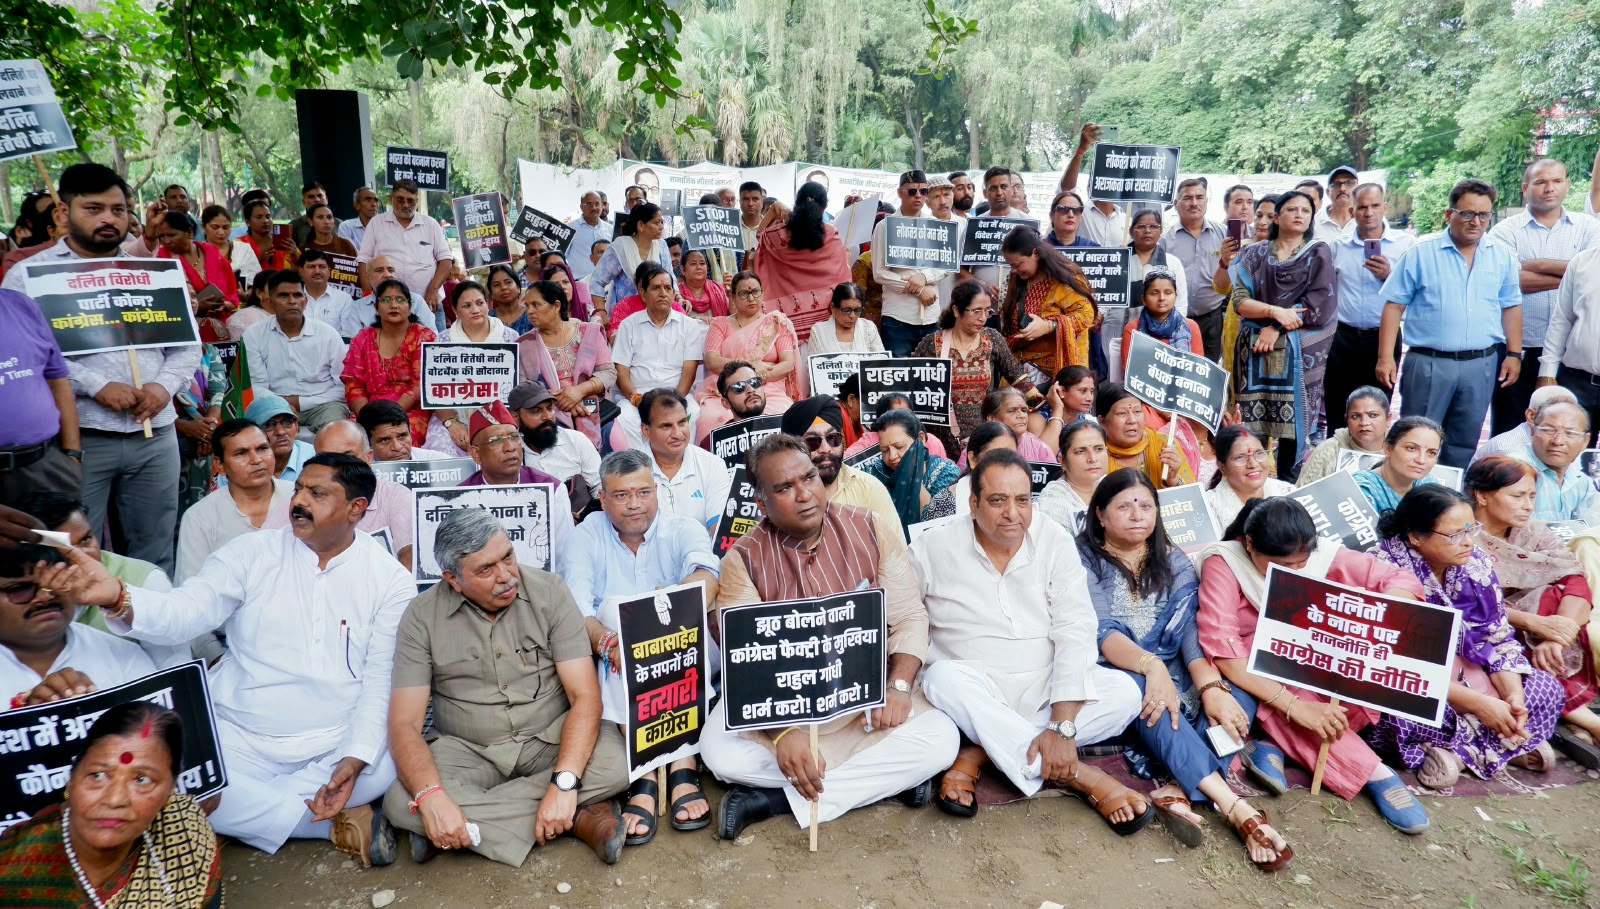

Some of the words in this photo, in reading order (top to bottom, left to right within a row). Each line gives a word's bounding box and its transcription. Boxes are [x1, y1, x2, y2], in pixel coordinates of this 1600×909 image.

[389, 153, 403, 164] भारत
[403, 151, 411, 166] को
[412, 155, 430, 168] बदनाम
[431, 157, 446, 169] करना
[1105, 150, 1128, 170] लोकतंत्र
[1129, 150, 1140, 169] को
[1140, 155, 1152, 170] मत
[1151, 152, 1167, 174] तोड़ो
[394, 168, 402, 181] बंद
[417, 169, 426, 184] बंद
[425, 171, 436, 185] करो
[1094, 176, 1124, 192] अराजकता
[1124, 177, 1134, 192] का
[1134, 178, 1153, 193] रास्ता
[1153, 175, 1168, 197] छोड़ो
[464, 199, 491, 213] दलित
[696, 207, 730, 223] STOP!
[464, 210, 495, 227] विरोधी
[524, 211, 550, 230] राहुल
[549, 221, 571, 241] गांधी
[978, 220, 989, 229] देश
[990, 220, 999, 229] में
[464, 224, 499, 240] कांग्रेस
[689, 221, 740, 236] SPONSORED
[896, 222, 918, 240] लोकतंत्र
[918, 223, 927, 240] को
[927, 227, 937, 241] मत
[936, 225, 949, 246] तोड़ो
[975, 231, 992, 240] विदेश
[993, 231, 1003, 240] में
[467, 235, 501, 250] हाय-हाय
[698, 233, 738, 248] ANARCHY
[981, 243, 999, 252] राहुल
[888, 245, 915, 260] अराजकता
[915, 247, 924, 260] का
[924, 248, 940, 262] रास्ता
[940, 246, 953, 266] छोड़ो
[963, 253, 977, 262] शर्म
[977, 252, 991, 262] करो
[1076, 251, 1086, 262] में
[1086, 252, 1108, 263] भारत
[1109, 251, 1122, 263] को
[331, 269, 358, 283] हिसाब
[1104, 264, 1122, 276] वाले
[66, 274, 106, 290] दलित
[110, 272, 152, 287] विरोधी
[77, 292, 111, 311] पार्टी
[112, 292, 154, 308] कौन?
[121, 308, 182, 324] कांग्रेस...
[228, 345, 238, 357] में
[433, 354, 458, 364] दलित
[460, 353, 485, 364] हितैषी
[487, 353, 507, 364] नहीं
[461, 365, 474, 377] की
[475, 366, 511, 377] सौदागर
[816, 360, 844, 371] दलितों
[1154, 347, 1195, 373] लोकतंत्र
[1195, 362, 1211, 379] को
[5, 368, 34, 380] Time
[864, 366, 911, 385] राहुल
[911, 362, 947, 383] गांधी
[1147, 364, 1175, 386] बंधक
[1174, 375, 1212, 398] बनाना
[431, 377, 500, 400] कांग्रेस!
[913, 387, 947, 410] छोड़ो
[1129, 375, 1145, 393] बंद
[1145, 384, 1167, 404] करो
[1176, 393, 1194, 411] बंद
[1194, 401, 1215, 423] करो
[715, 436, 738, 459] भारत
[738, 427, 750, 453] को
[395, 466, 408, 484] में
[410, 467, 462, 483] अराजकता
[1032, 467, 1049, 484] को
[489, 505, 523, 519] ठाना
[527, 501, 542, 519] है,
[1160, 499, 1194, 518] साहेब
[1337, 496, 1379, 546] कांग्रेस
[1325, 592, 1388, 623] दलितों
[755, 615, 783, 638] झूठ
[783, 607, 827, 630] बोलने
[827, 600, 856, 624] वाली
[1307, 603, 1326, 624] के
[1327, 614, 1371, 640] नाम
[1372, 625, 1401, 645] पर
[631, 626, 699, 660] बाबासाहेब
[729, 642, 779, 664] कांग्रेस
[778, 636, 821, 659] फैक्ट्री
[821, 635, 834, 654] के
[833, 626, 879, 655] मुखिया
[1311, 629, 1371, 658] राजनीति
[1373, 644, 1390, 661] ही
[635, 664, 650, 684] के
[650, 652, 682, 680] सपनों
[682, 647, 699, 668] की
[775, 669, 818, 690] राहुल
[819, 659, 843, 683] गांधी
[1270, 637, 1335, 671] कांग्रेस
[1337, 657, 1366, 682] की
[1370, 666, 1431, 698] नीति!
[636, 667, 699, 723] हत्यारी
[742, 697, 773, 720] शर्म
[773, 694, 812, 717] करो!
[816, 688, 838, 713] शर्म
[838, 681, 862, 705] करो
[29, 715, 61, 748] में
[644, 711, 690, 745] कांग्रेस
